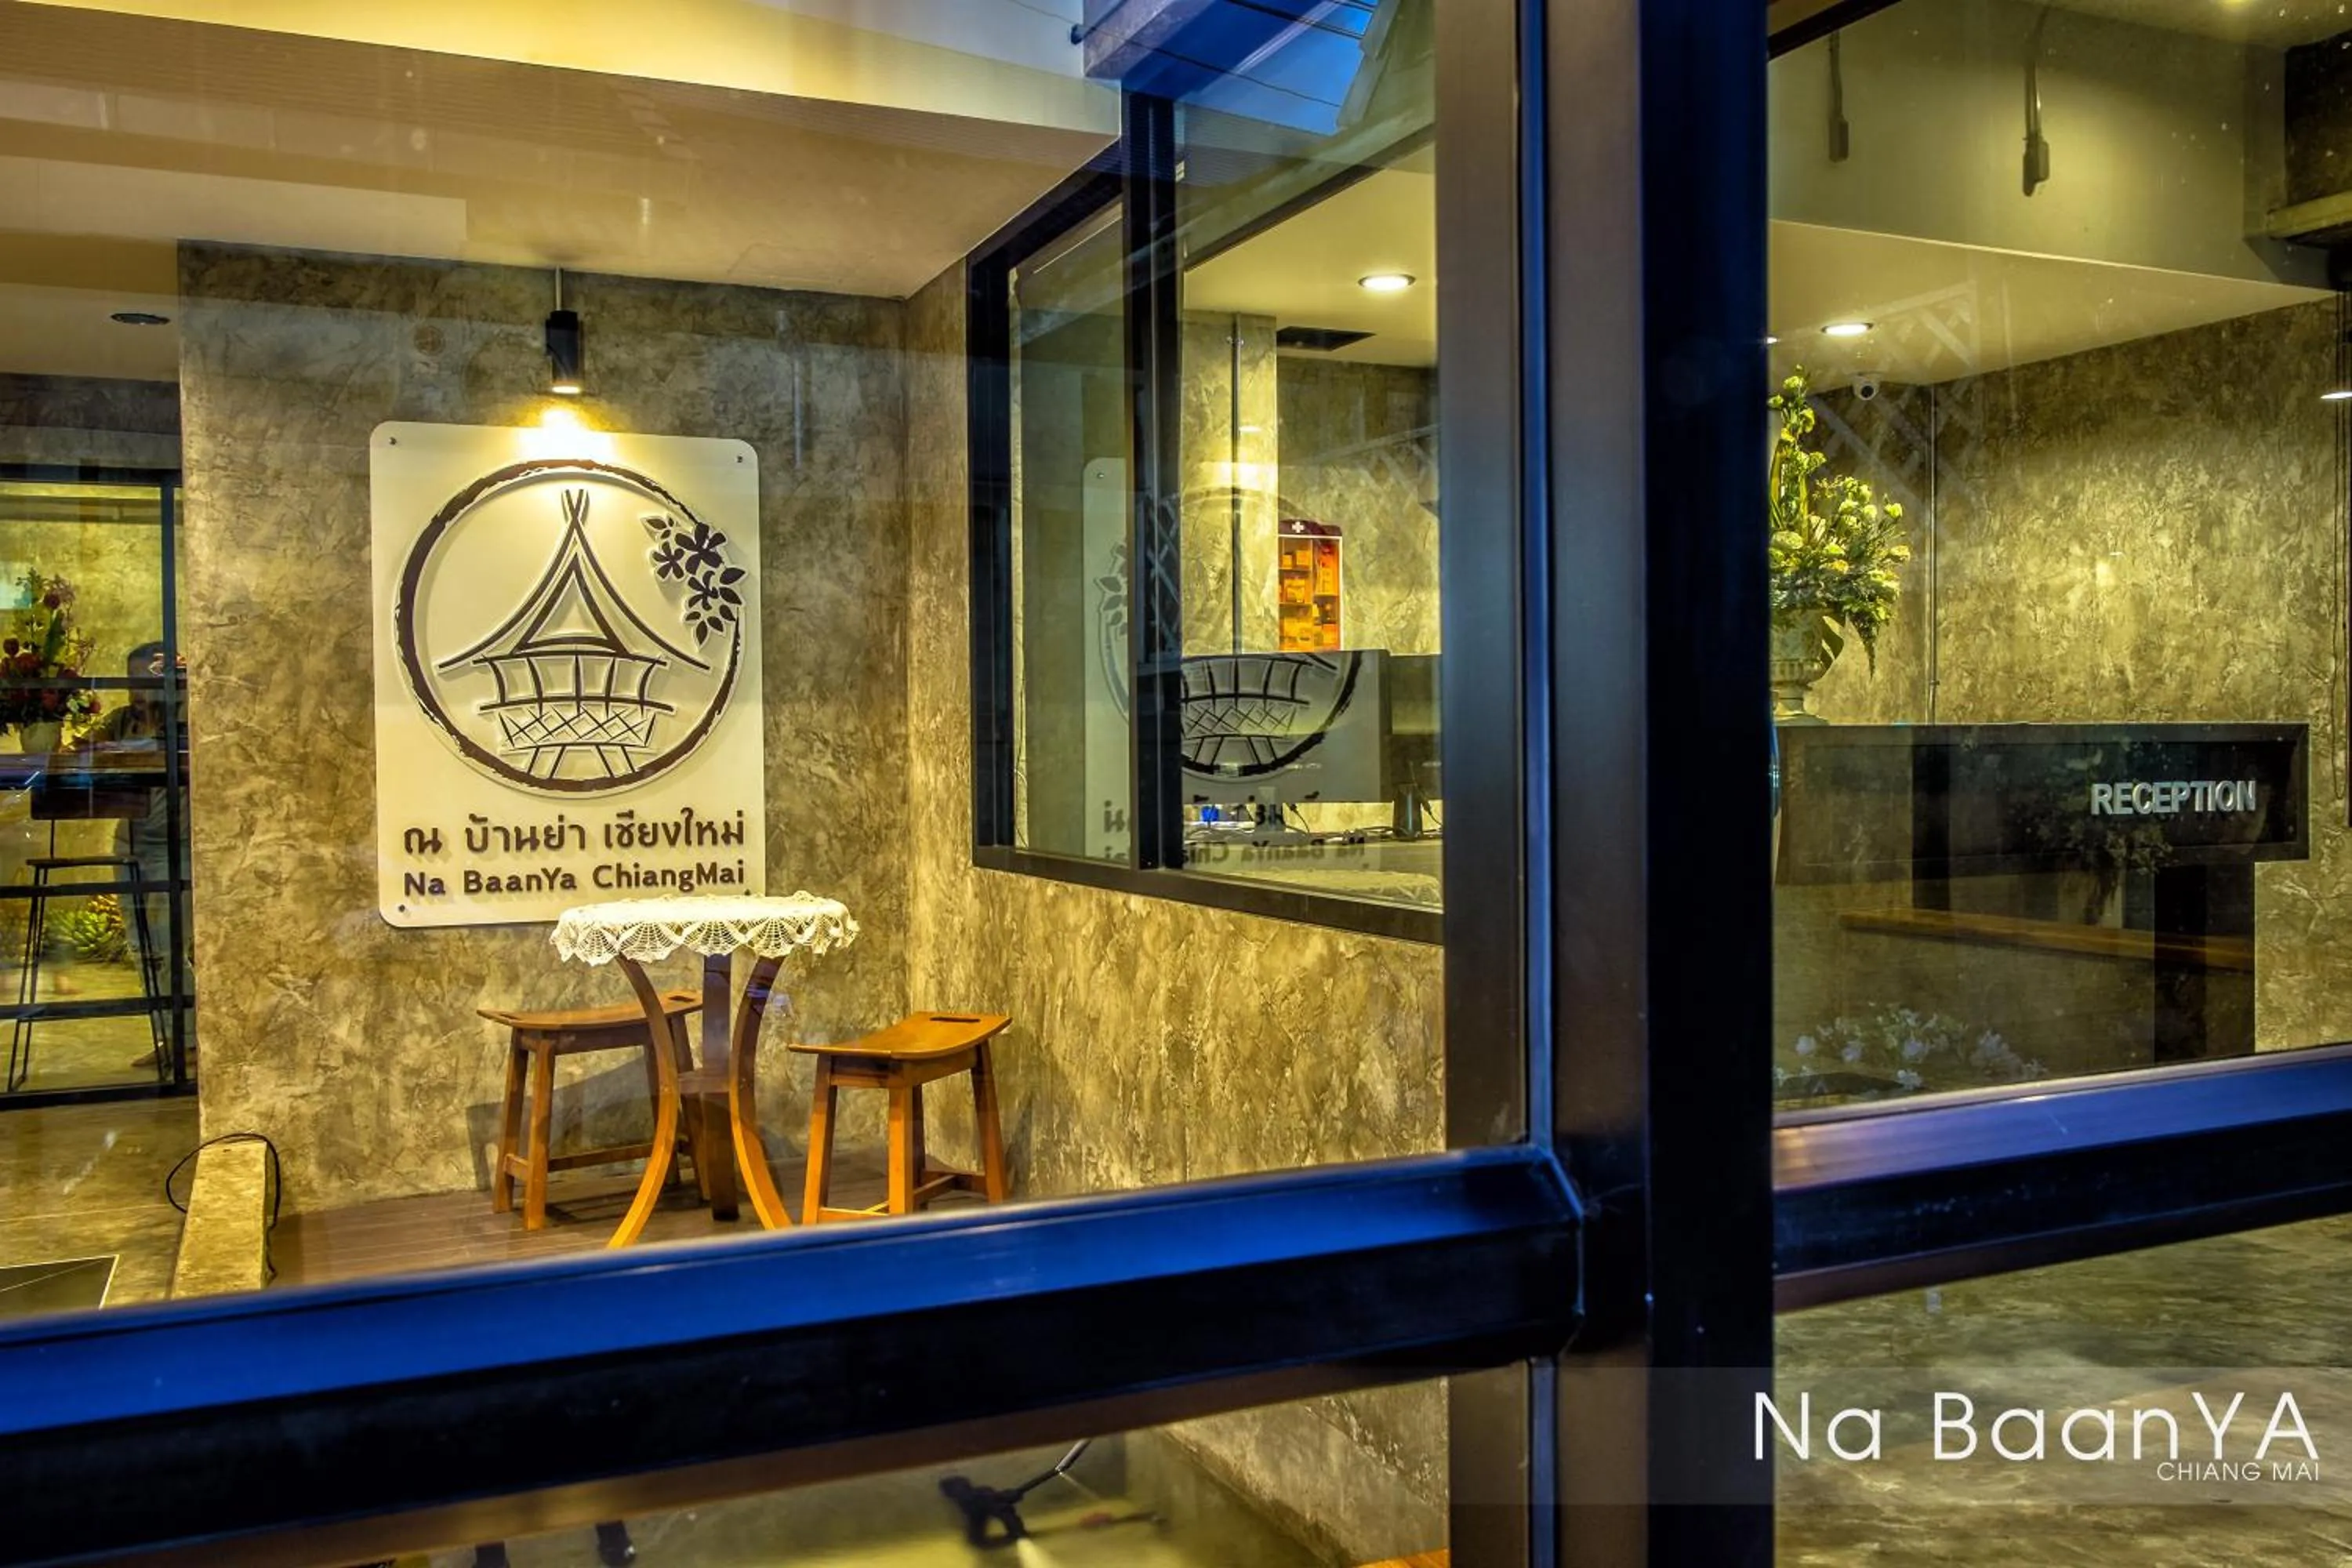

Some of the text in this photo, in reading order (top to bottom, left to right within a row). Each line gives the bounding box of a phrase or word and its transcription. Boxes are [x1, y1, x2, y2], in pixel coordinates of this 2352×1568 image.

[2090, 780, 2256, 815] RECEPTION
[404, 827, 441, 855] ณ
[604, 808, 745, 849] เชียงใหม่
[403, 859, 745, 897] Na BaanYa ChiangMai
